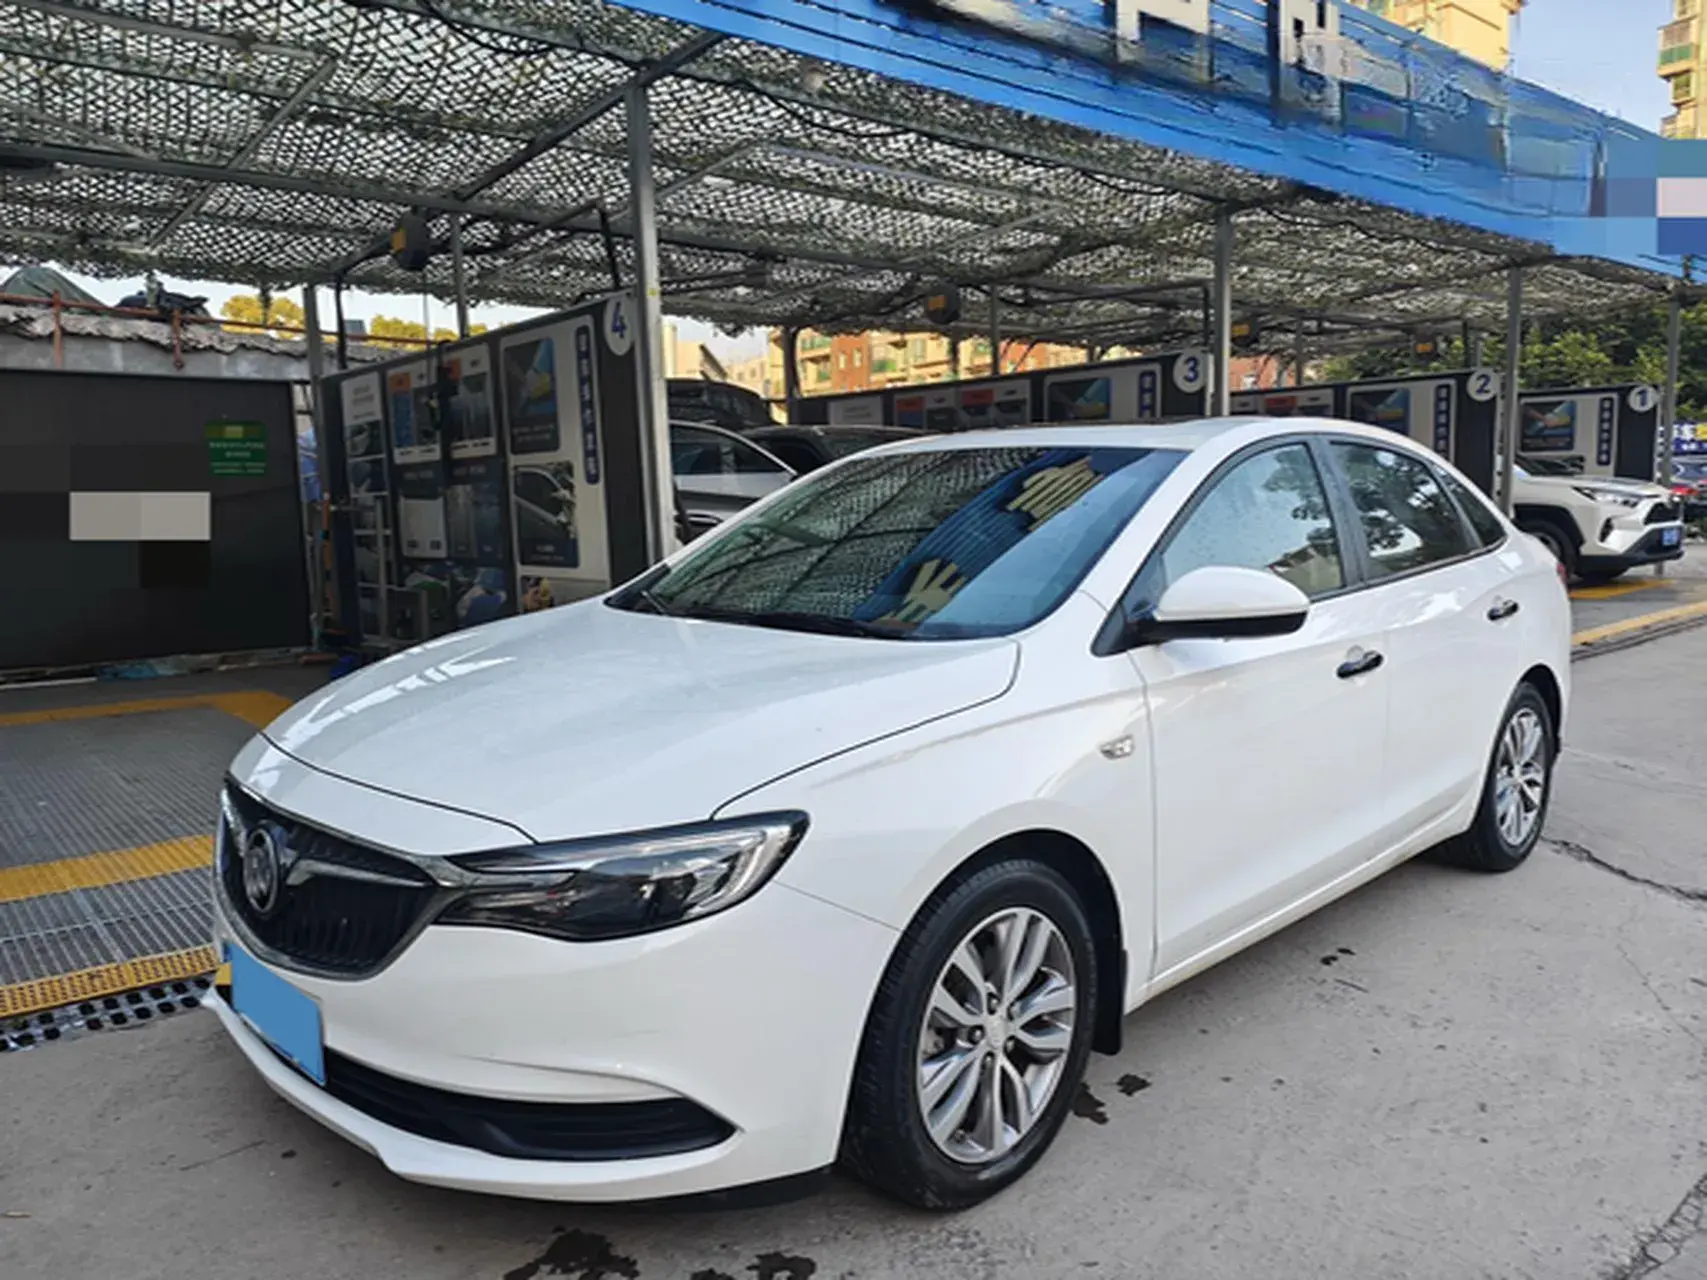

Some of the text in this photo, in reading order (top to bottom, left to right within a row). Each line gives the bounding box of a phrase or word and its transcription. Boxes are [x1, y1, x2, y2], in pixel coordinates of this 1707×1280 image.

[611, 301, 627, 340] 4
[1183, 356, 1200, 383] 3
[1475, 374, 1491, 394] 2
[1637, 388, 1648, 408] 1
